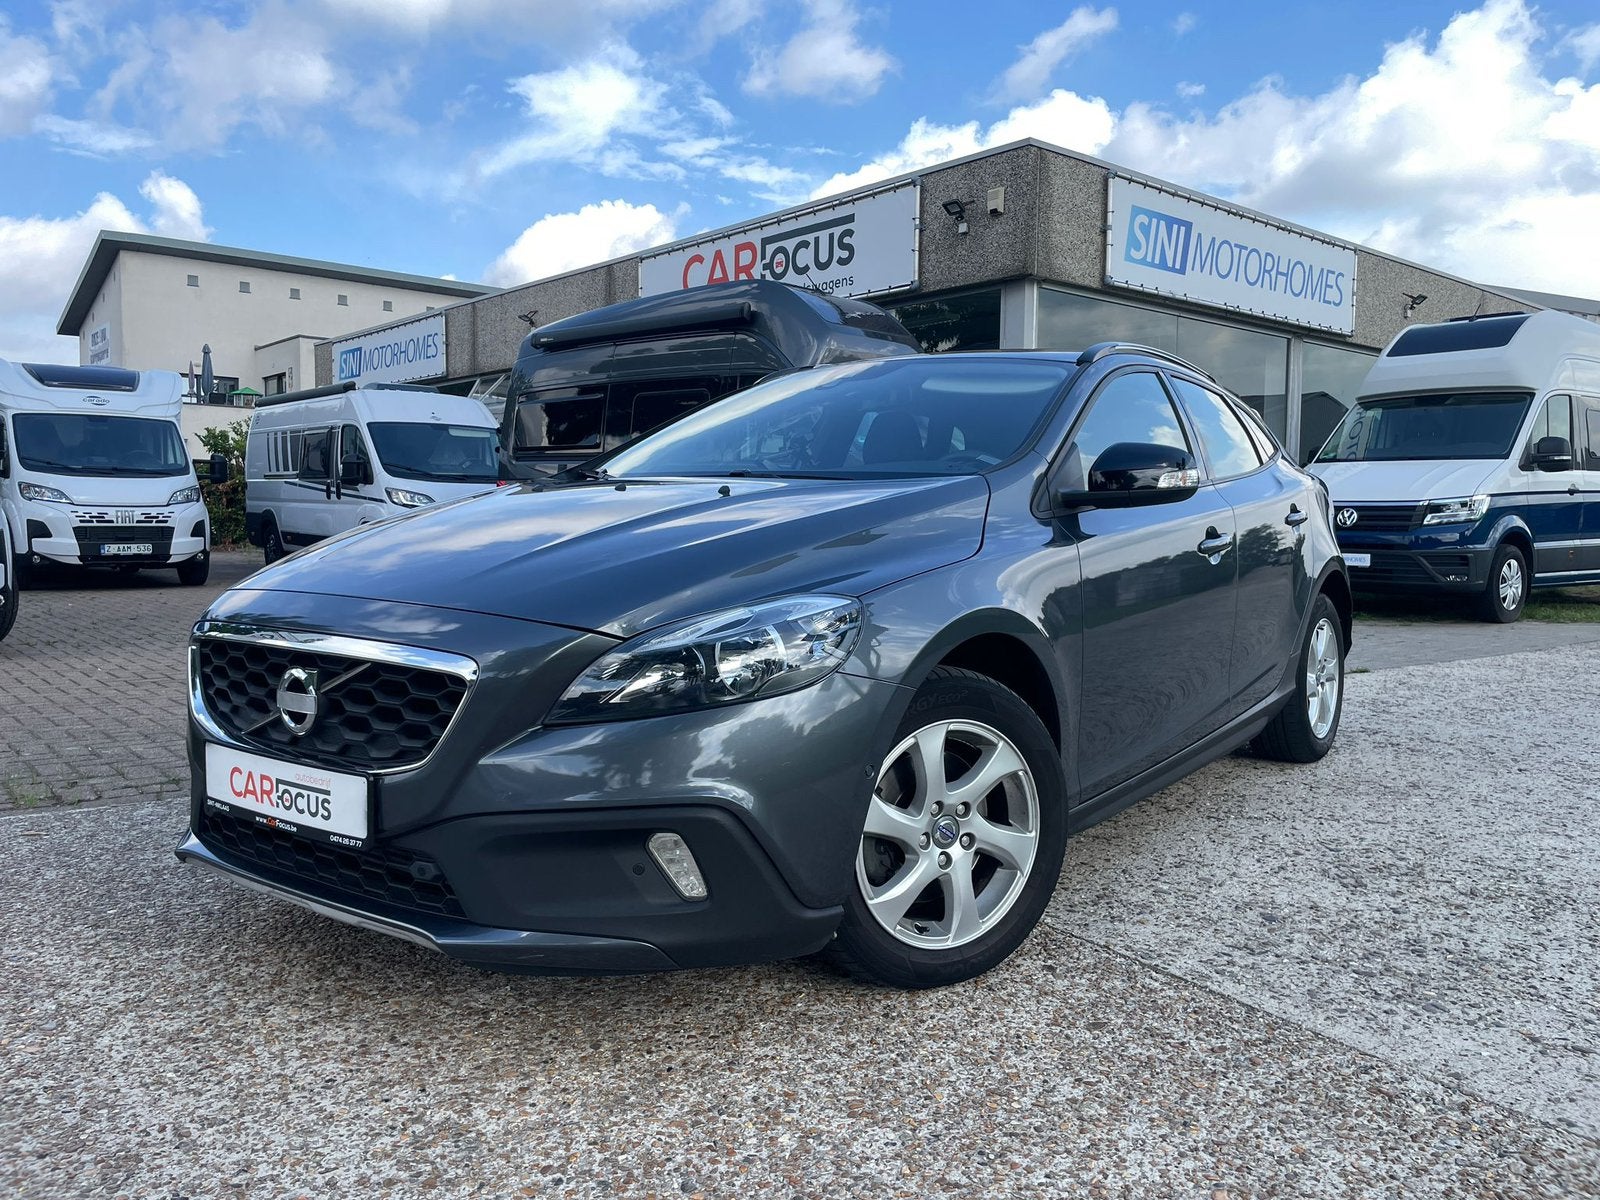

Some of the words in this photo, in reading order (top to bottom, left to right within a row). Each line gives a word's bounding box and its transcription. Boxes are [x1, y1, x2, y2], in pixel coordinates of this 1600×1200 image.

[1130, 214, 1186, 270] SINI
[1191, 232, 1344, 307] MOTORHOMES
[340, 350, 360, 379] SINI
[362, 332, 439, 373] MOTORHOMES
[115, 510, 135, 524] FIAT
